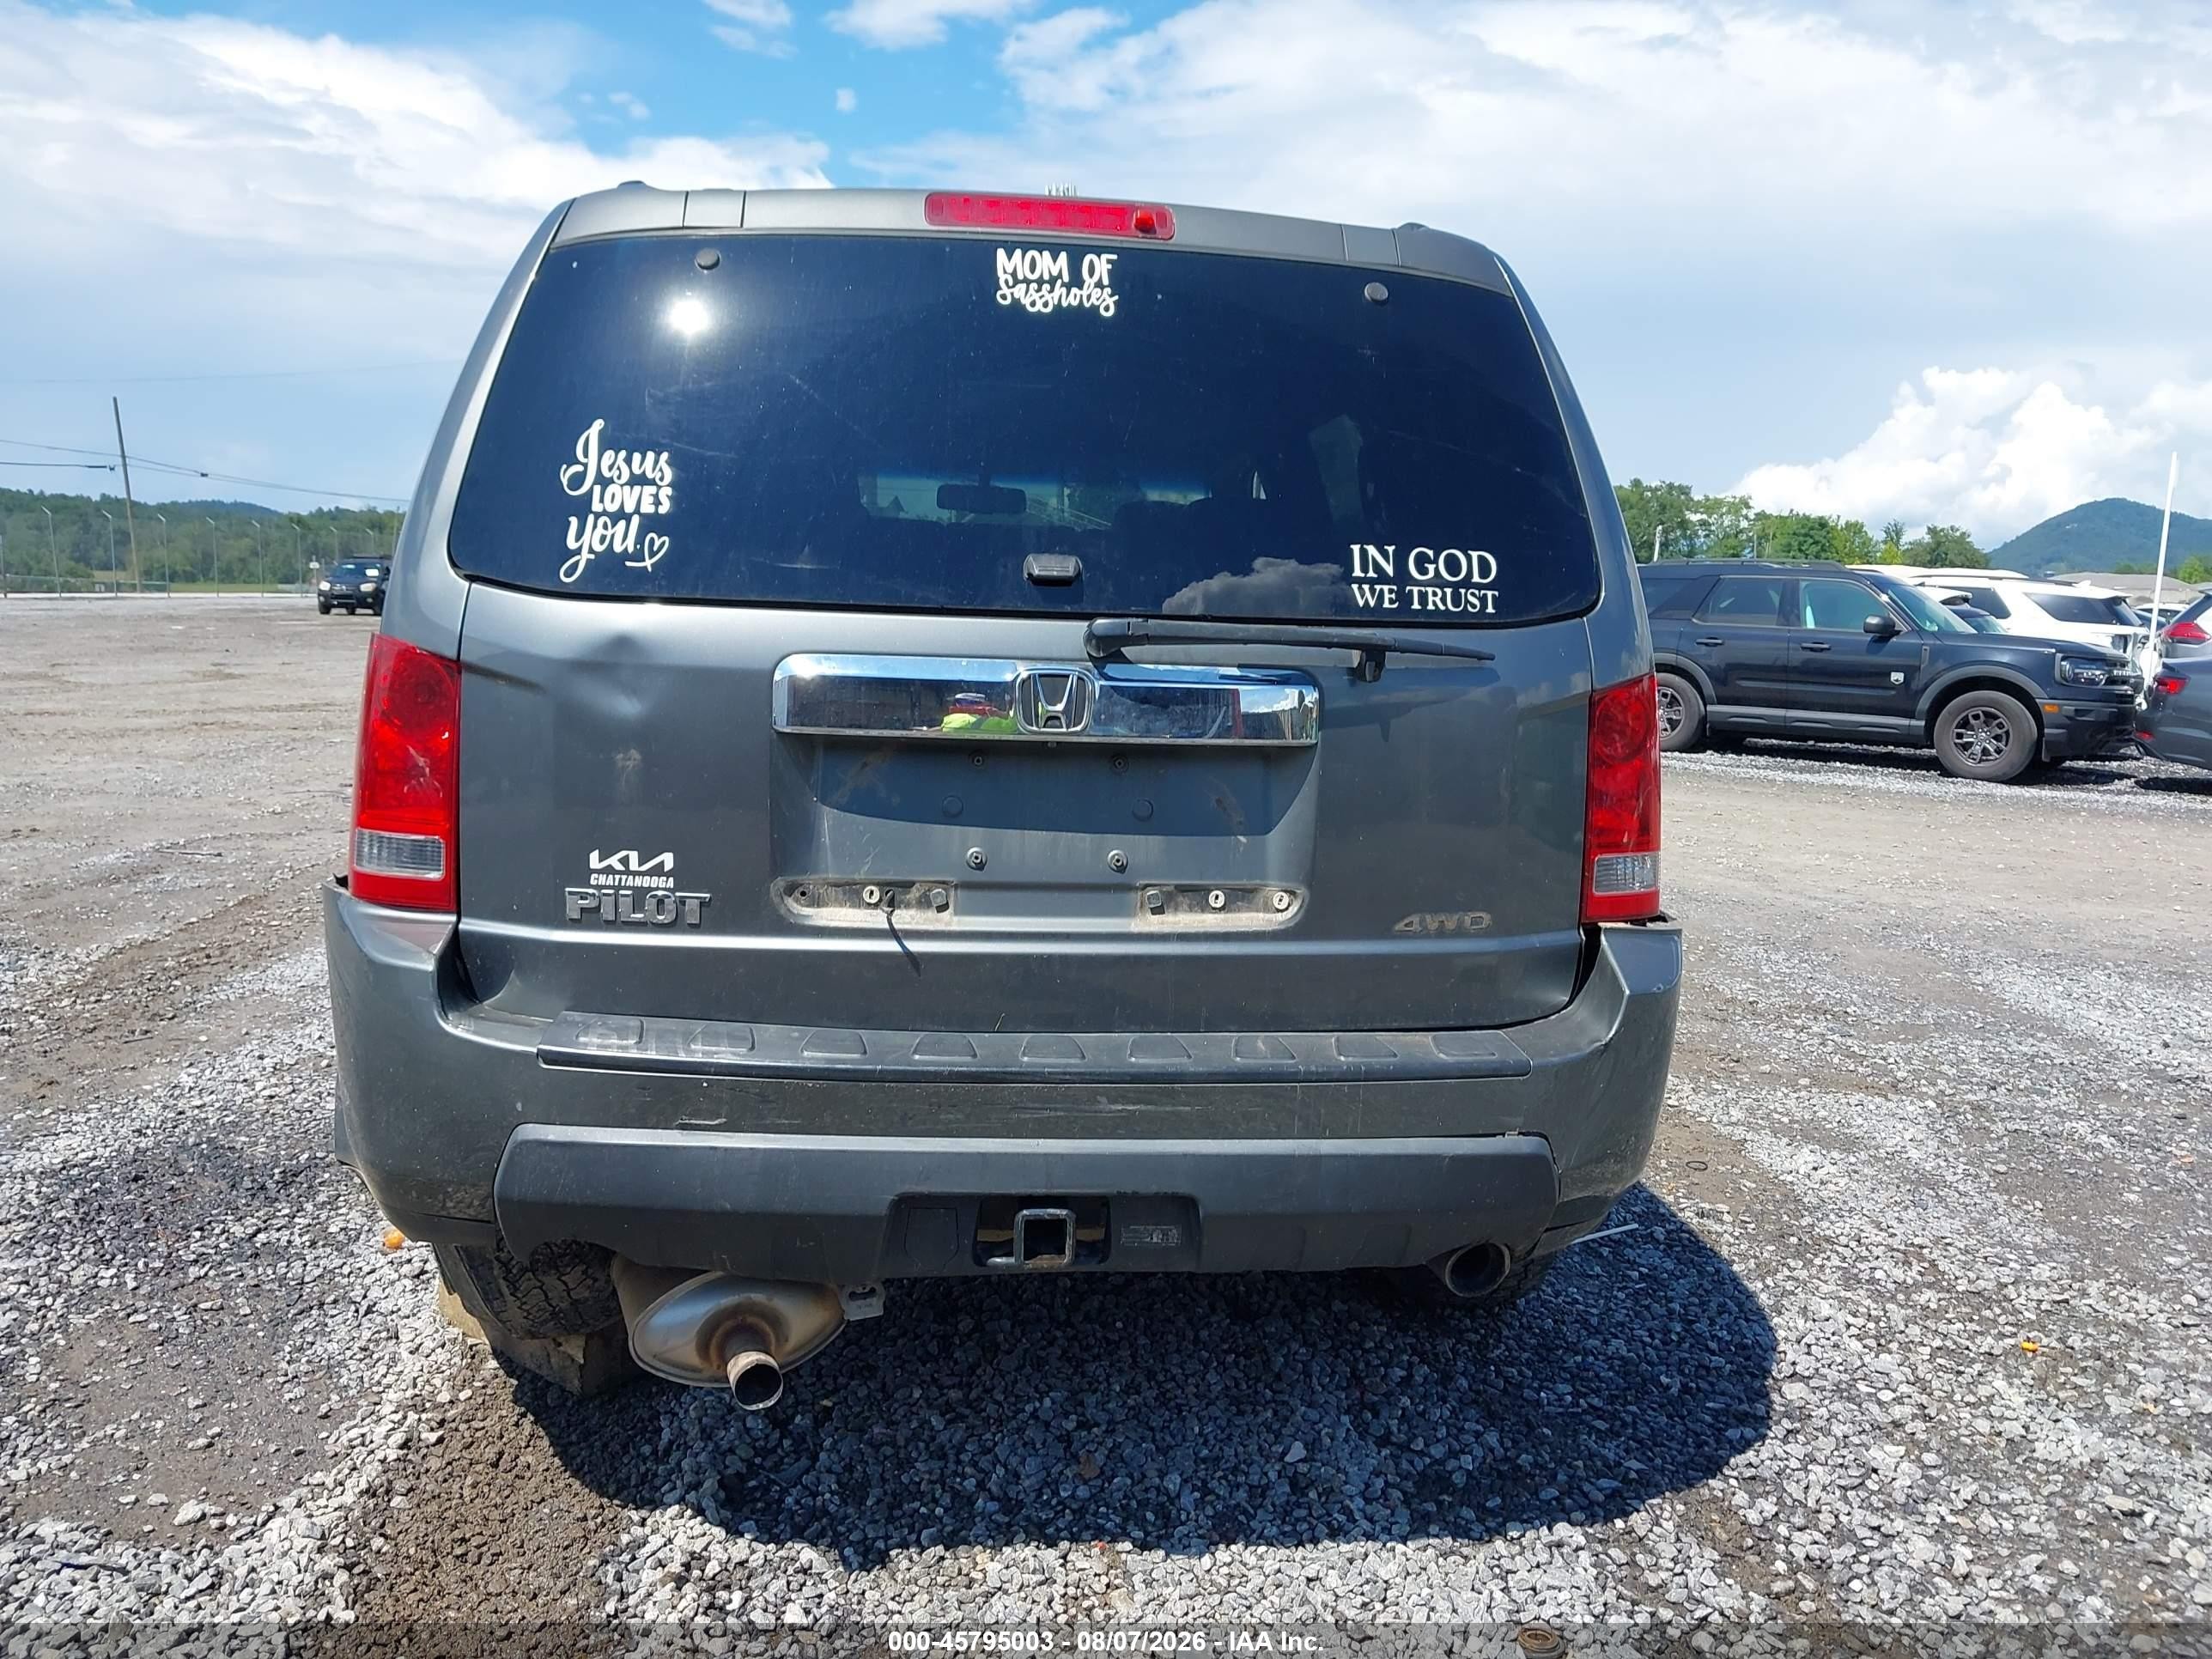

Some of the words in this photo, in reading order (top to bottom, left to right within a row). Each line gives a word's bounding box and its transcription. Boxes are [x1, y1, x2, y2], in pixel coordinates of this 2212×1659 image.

[996, 247, 1069, 283] MOM
[1082, 253, 1118, 285] OF
[560, 418, 672, 496] Jesus
[592, 483, 672, 514] LOVES
[1350, 544, 1395, 578] IN
[1408, 547, 1497, 583] GOD
[1351, 584, 1399, 608] WE
[1406, 586, 1499, 613] TRUST
[589, 848, 674, 872] KIA
[590, 873, 674, 889] CHATTANOOGA
[564, 887, 712, 925] PILOT
[1394, 911, 1492, 933] 4WD
